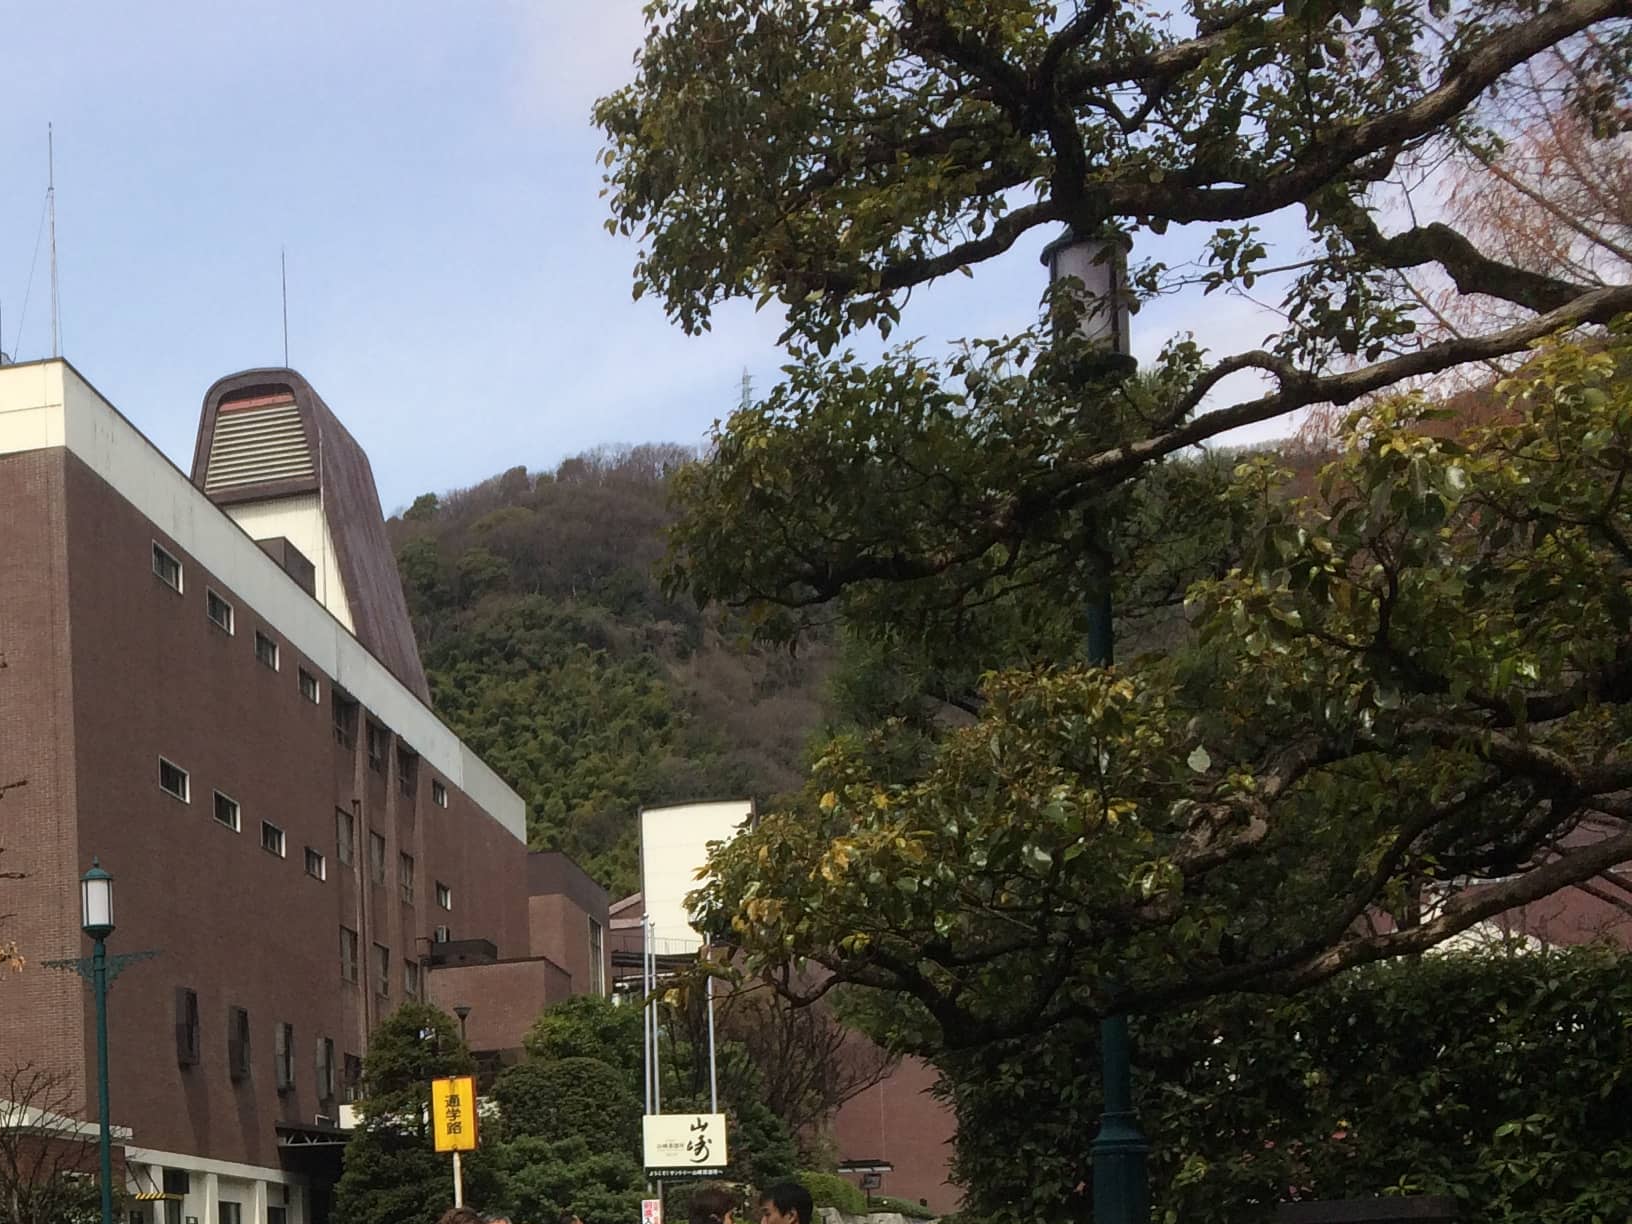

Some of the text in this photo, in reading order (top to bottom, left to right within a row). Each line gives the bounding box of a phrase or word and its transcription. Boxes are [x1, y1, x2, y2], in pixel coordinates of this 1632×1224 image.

[444, 1094, 463, 1136] 通学路
[686, 1117, 713, 1164] 山崎
